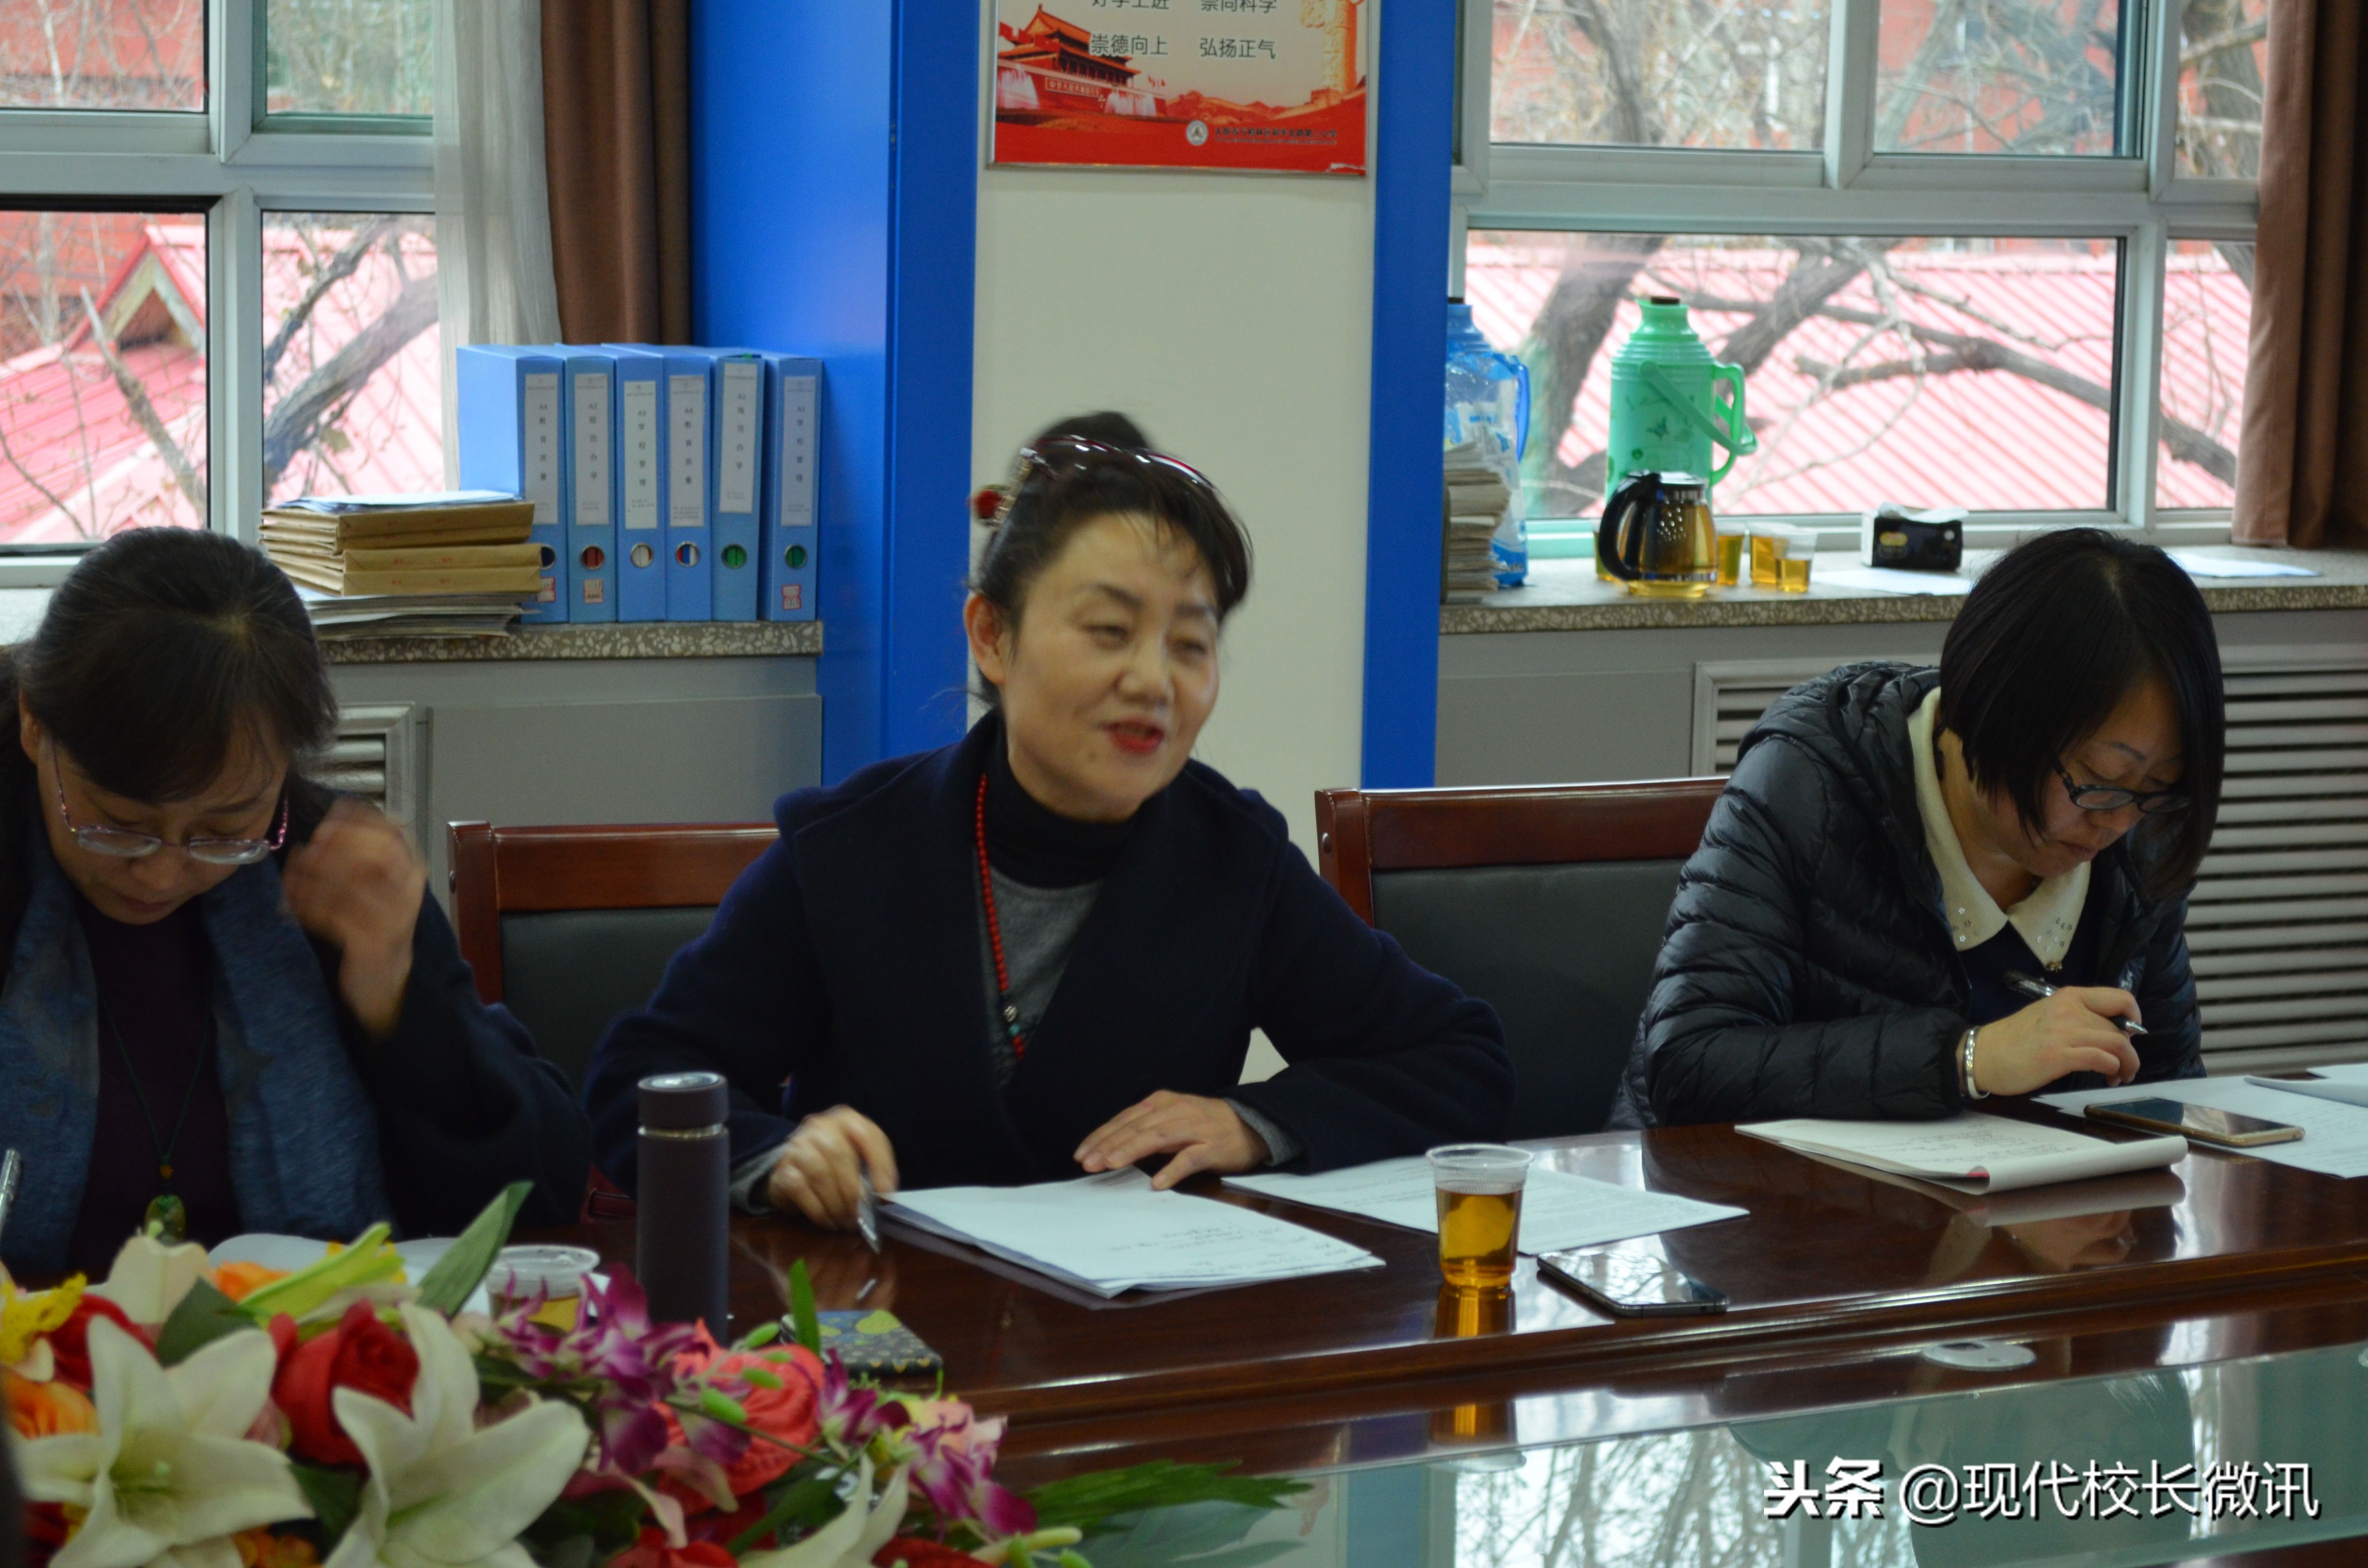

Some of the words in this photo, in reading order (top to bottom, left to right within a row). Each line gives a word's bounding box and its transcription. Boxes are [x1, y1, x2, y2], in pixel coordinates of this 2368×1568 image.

[1091, 34, 1169, 55] 崇德向上
[1199, 37, 1276, 60] 弘扬正气
